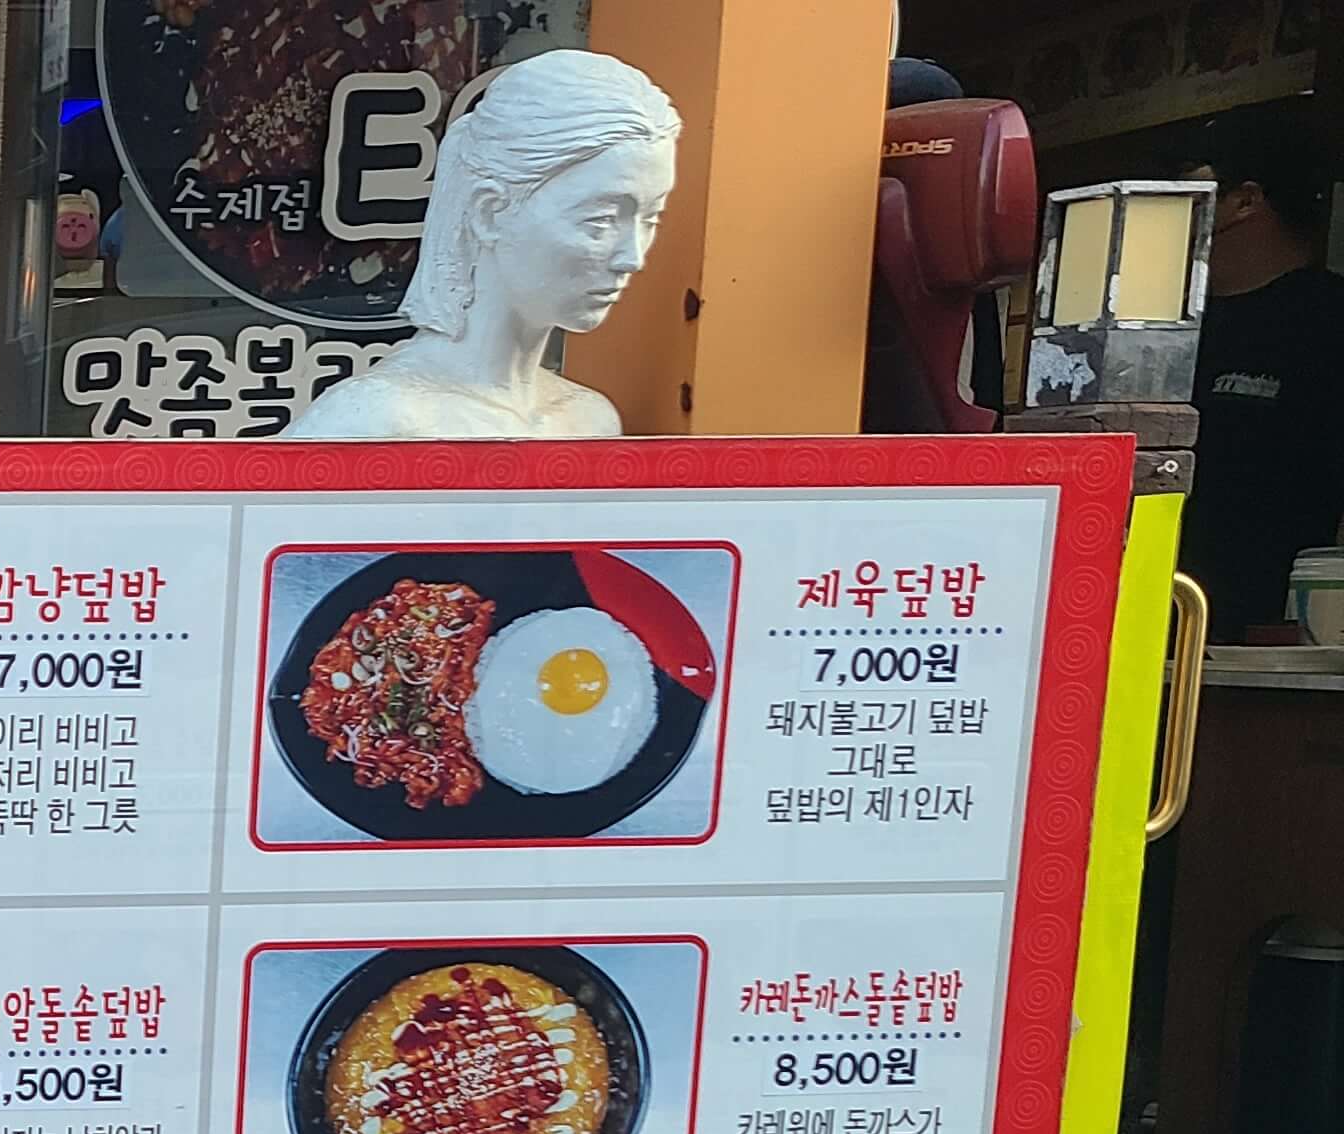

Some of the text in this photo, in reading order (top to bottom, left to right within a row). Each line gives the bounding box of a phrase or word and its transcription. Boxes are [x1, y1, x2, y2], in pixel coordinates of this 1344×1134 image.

[65, 326, 387, 437] 맛좀볼
[796, 560, 987, 619] 제육덮밥
[813, 643, 960, 687] 7,000원
[55, 713, 140, 751] 비비고
[765, 698, 990, 737] 돼지불고기 덮밥
[53, 755, 138, 793] 비비고
[826, 743, 918, 779] 그대로
[47, 798, 76, 835] 한
[82, 798, 140, 834] 그릇
[765, 785, 975, 824] 덮밥의 제1인자
[739, 969, 964, 1027] 카레돈까스돌솥덮밥
[773, 1047, 919, 1090] 8,500원
